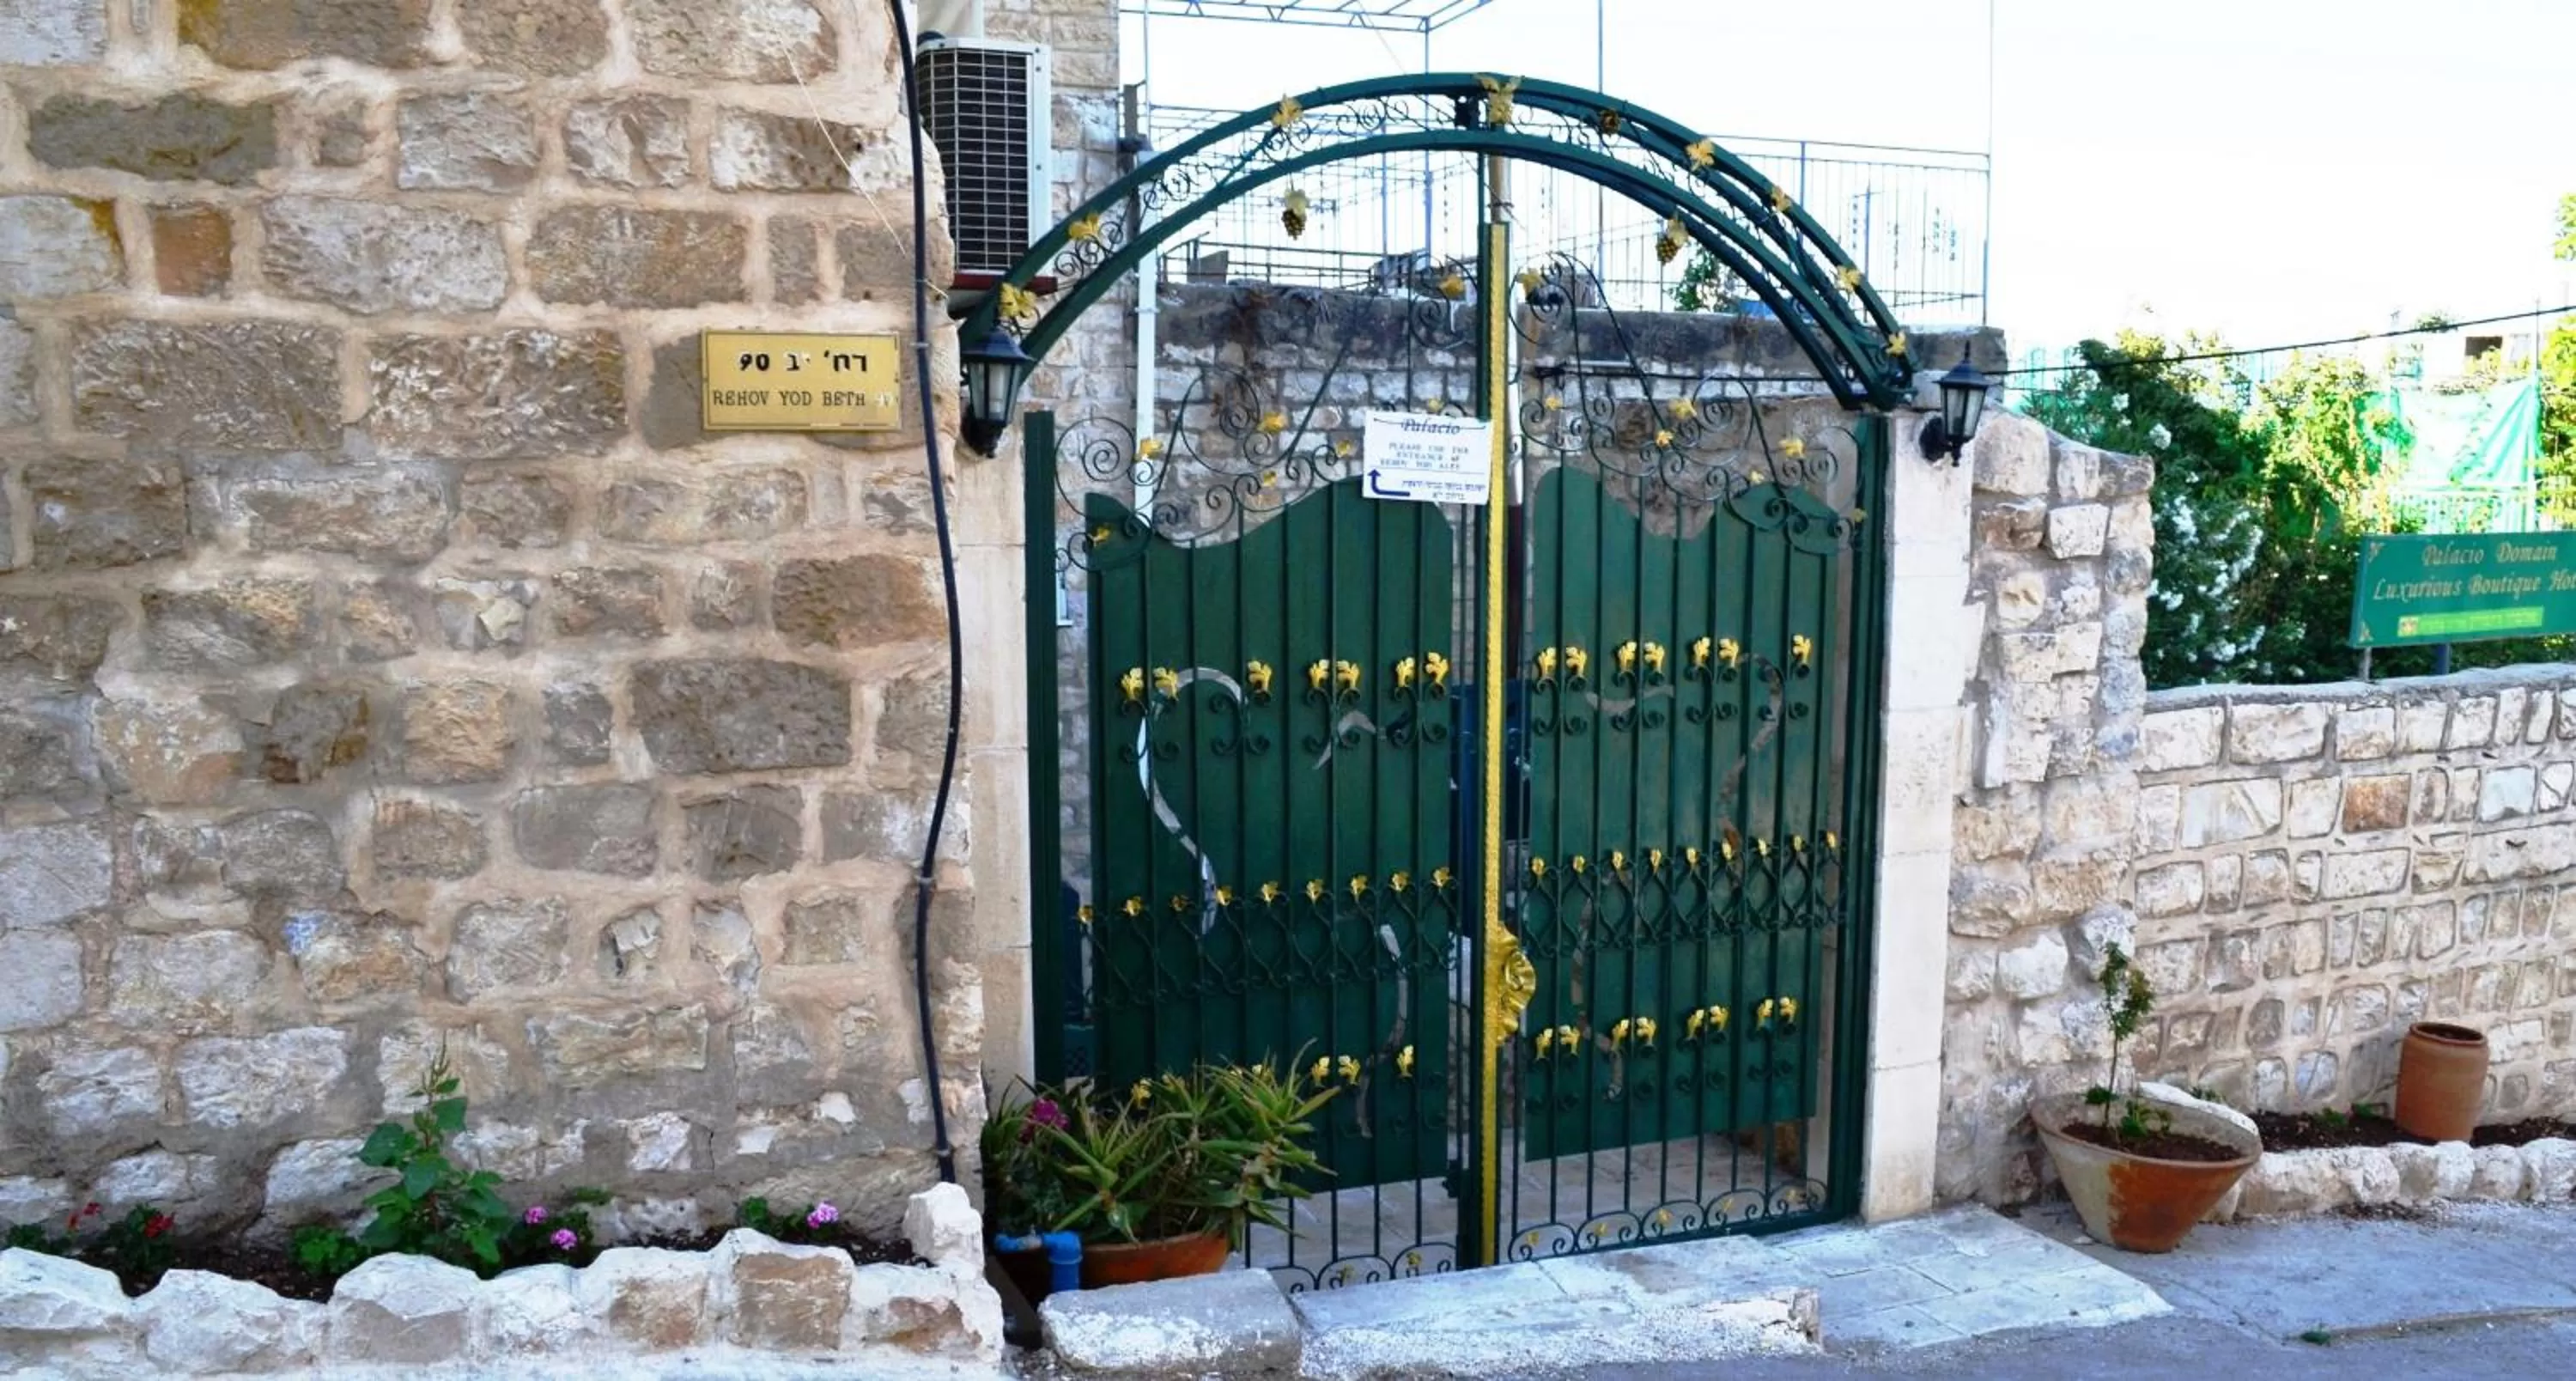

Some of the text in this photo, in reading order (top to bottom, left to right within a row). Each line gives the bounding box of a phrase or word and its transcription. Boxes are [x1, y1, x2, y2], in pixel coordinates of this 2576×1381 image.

[739, 353, 770, 372] 90
[714, 390, 770, 406] REHOV
[778, 390, 812, 406] YOD
[822, 391, 866, 406] BETH
[1400, 417, 1461, 435] Palacio
[2421, 539, 2558, 566] Palacio Domain
[2373, 576, 2463, 603] Luxurious
[2469, 571, 2542, 601] Boutique
